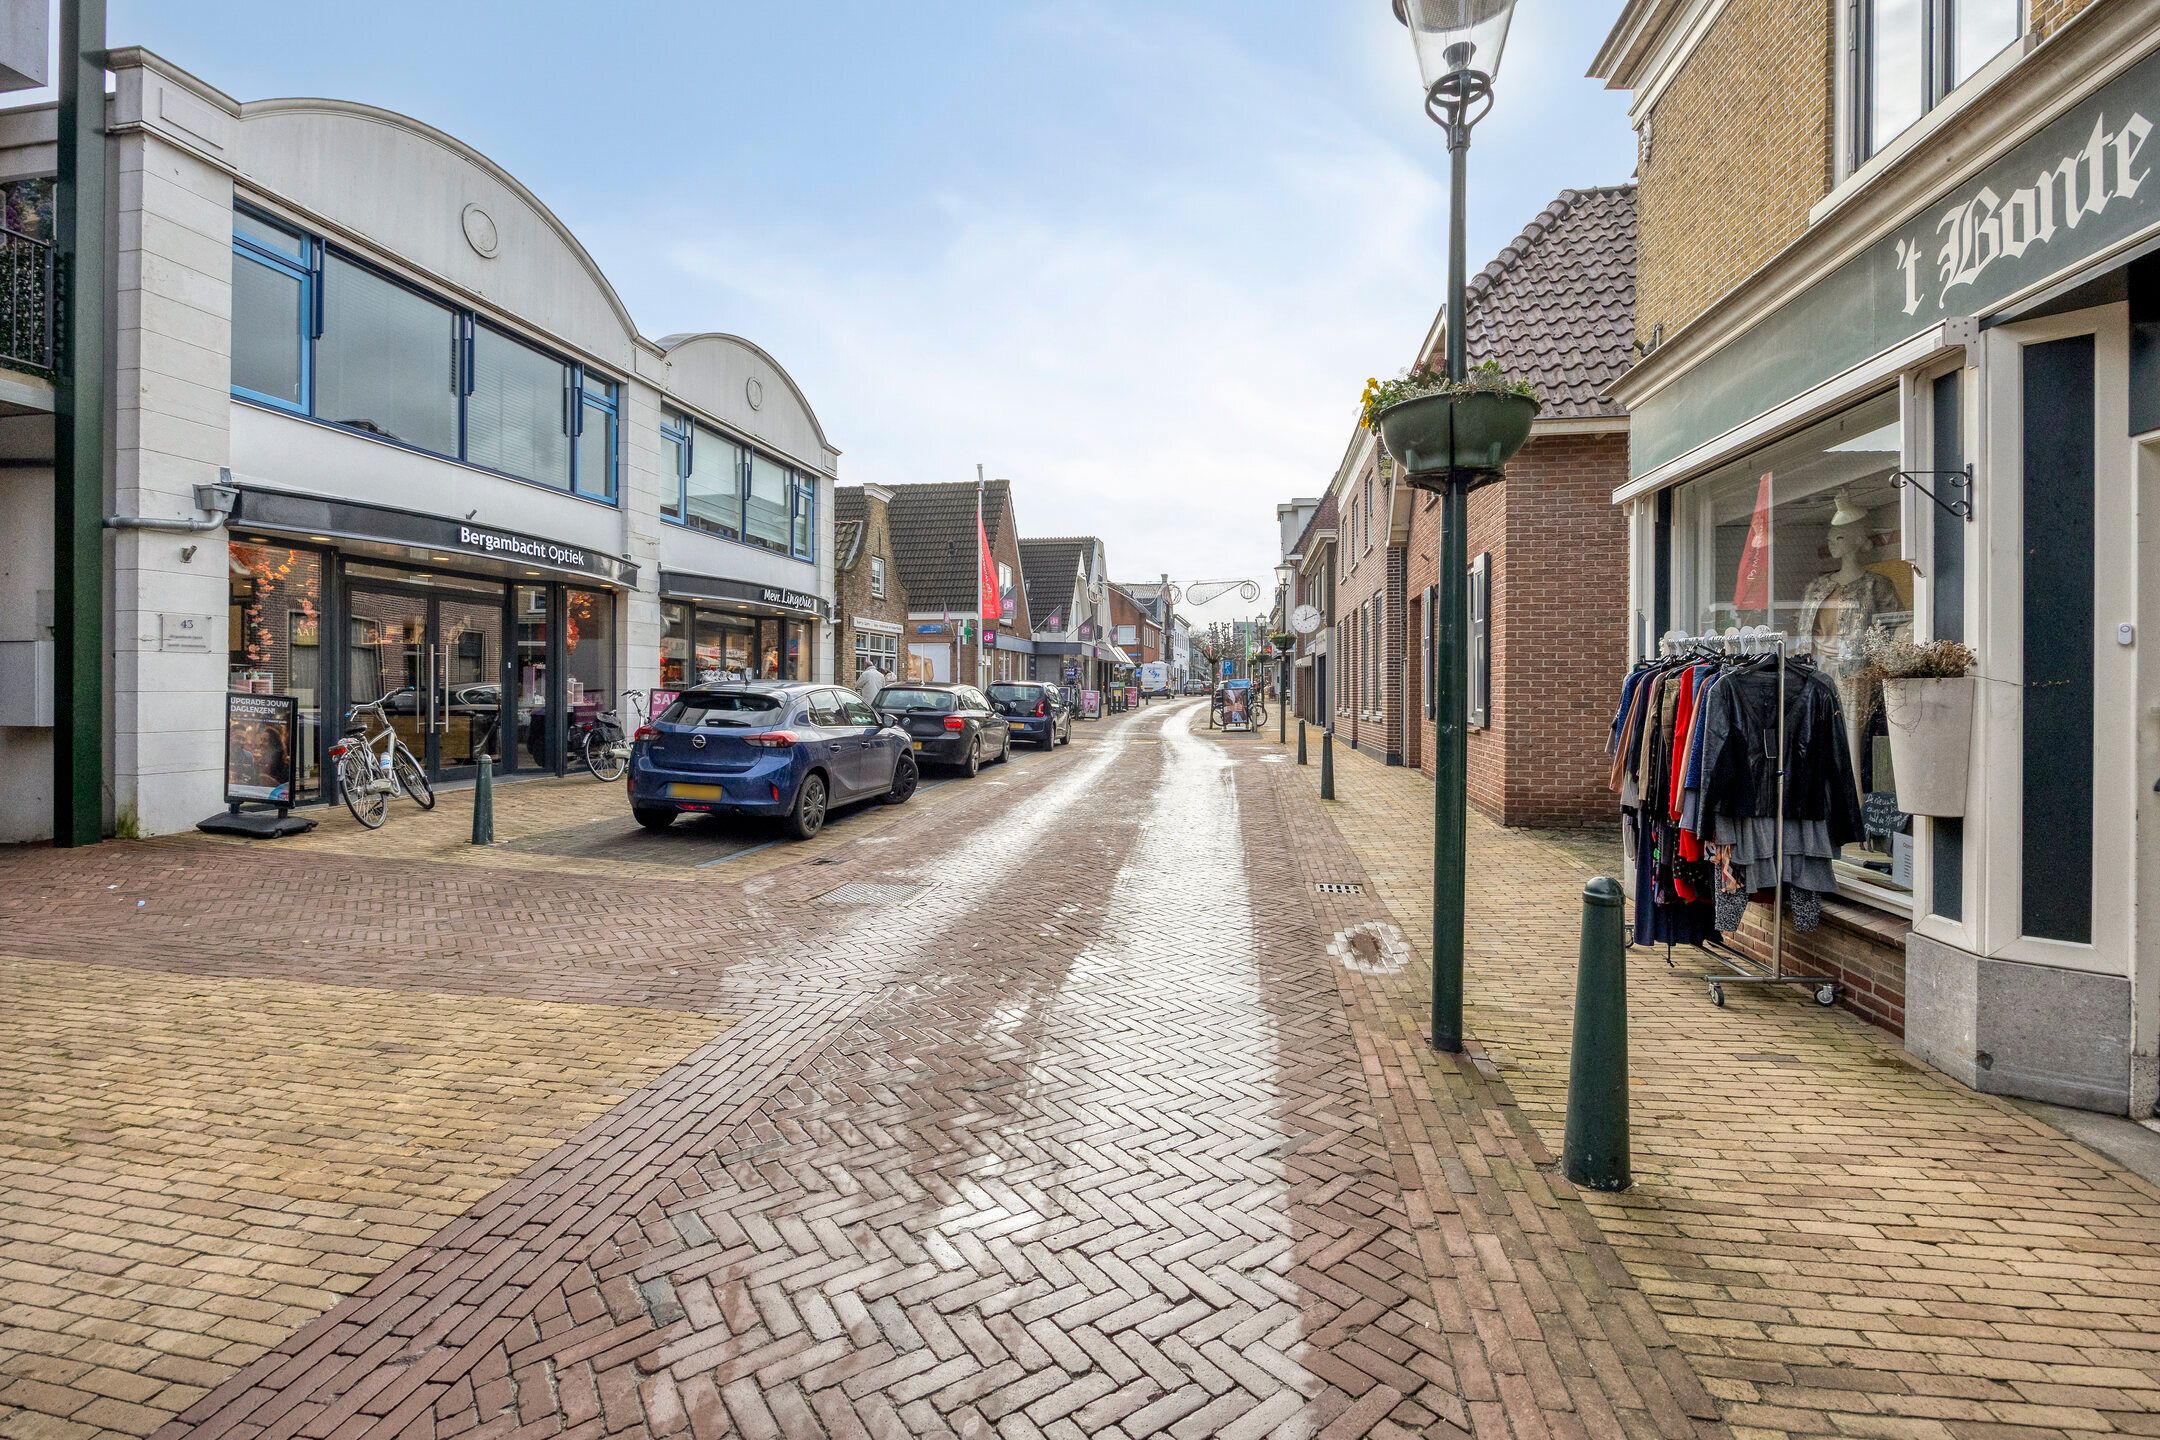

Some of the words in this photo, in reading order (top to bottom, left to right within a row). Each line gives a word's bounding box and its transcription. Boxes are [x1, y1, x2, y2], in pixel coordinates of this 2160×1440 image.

[1936, 112, 2154, 309] Bonte
[461, 527, 546, 557] Bergambacht
[548, 546, 584, 565] Optiek
[764, 589, 780, 603] Mevr.
[781, 588, 812, 608] Lingerie
[230, 697, 266, 706] UPGRADE
[267, 700, 290, 708] JOUW
[230, 705, 276, 715] DAGLENZEN!
